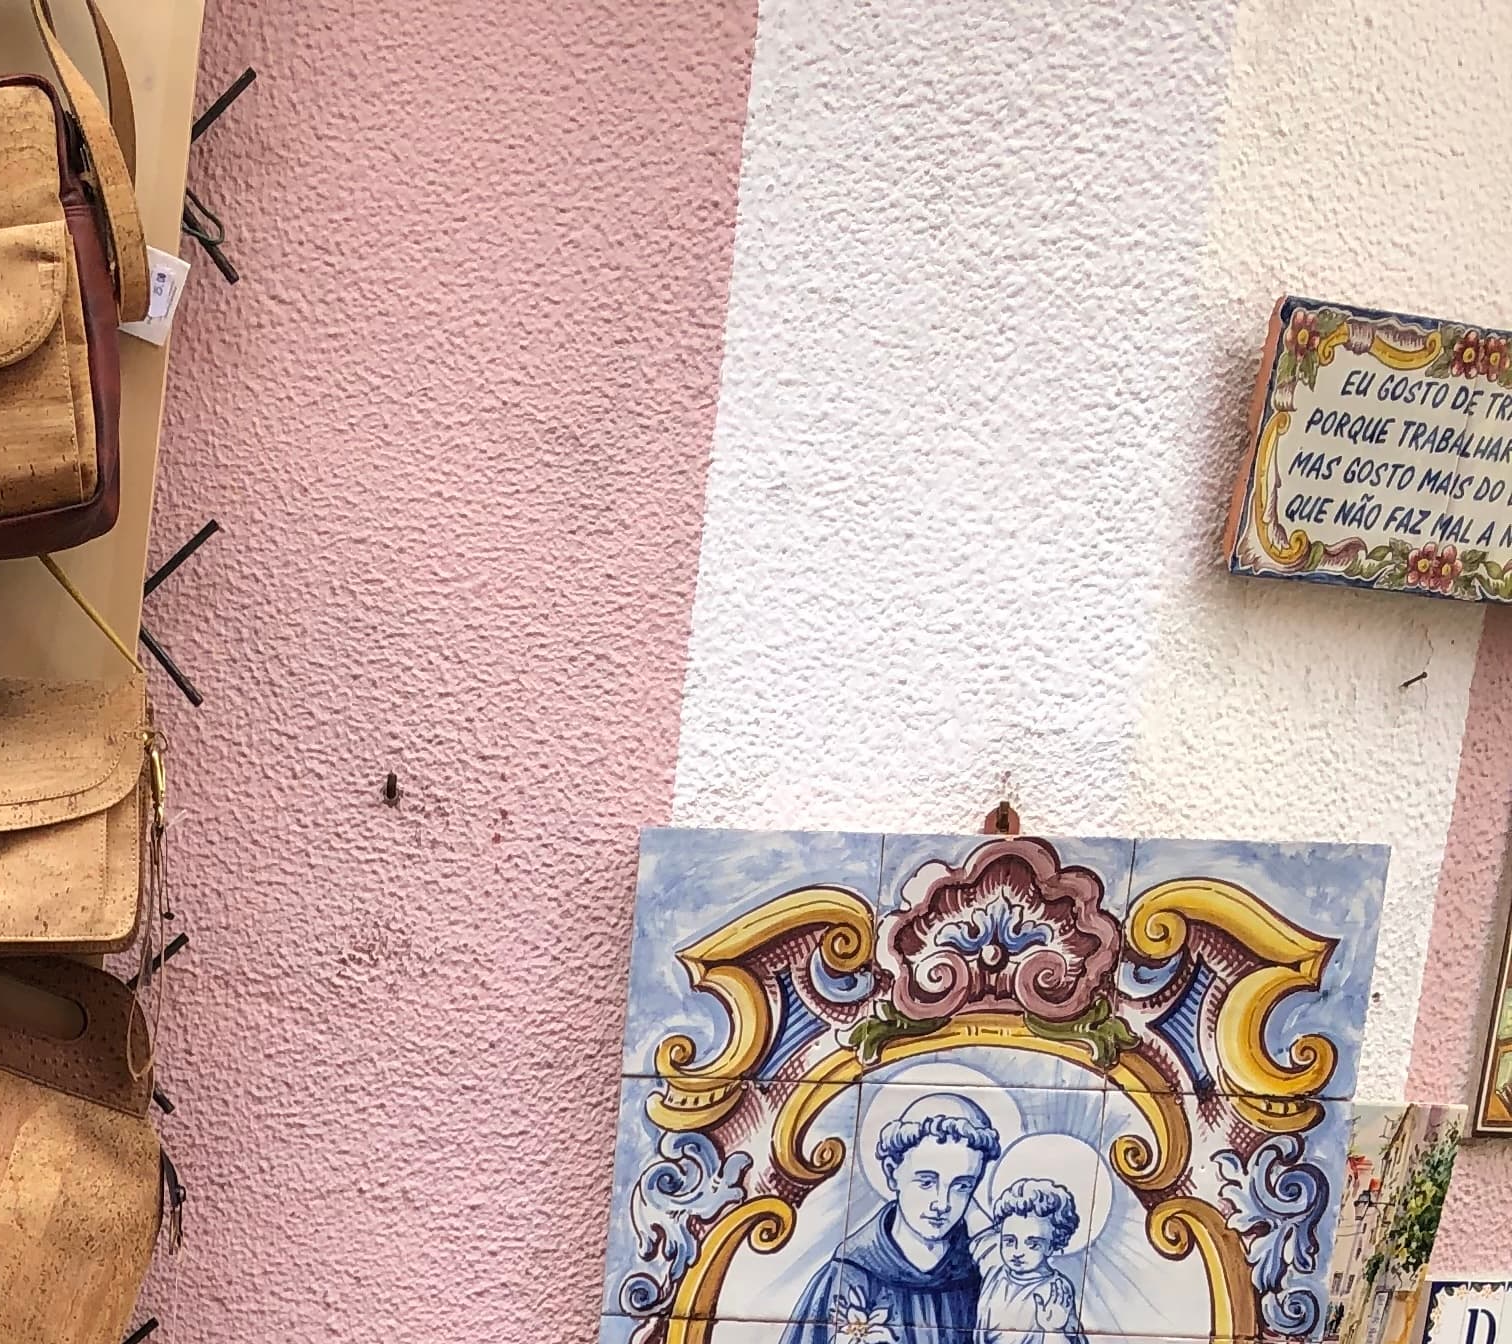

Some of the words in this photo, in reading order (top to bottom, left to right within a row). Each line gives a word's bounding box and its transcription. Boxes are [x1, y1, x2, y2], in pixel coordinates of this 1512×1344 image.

[1341, 370, 1376, 398] EU
[1377, 375, 1449, 409] GOSTO
[1451, 384, 1484, 416] DE
[1485, 392, 1512, 422] TR
[1305, 407, 1396, 445] PORQUE
[1288, 451, 1341, 481] MAS
[1343, 457, 1416, 491] GOSTO
[1417, 467, 1475, 499] MAIS
[1473, 476, 1505, 503] DO
[1285, 494, 1334, 524] QUE
[1334, 493, 1383, 531] NÃO
[1383, 506, 1431, 535] FAZ
[1431, 513, 1474, 544] MAL
[1476, 520, 1495, 547] A
